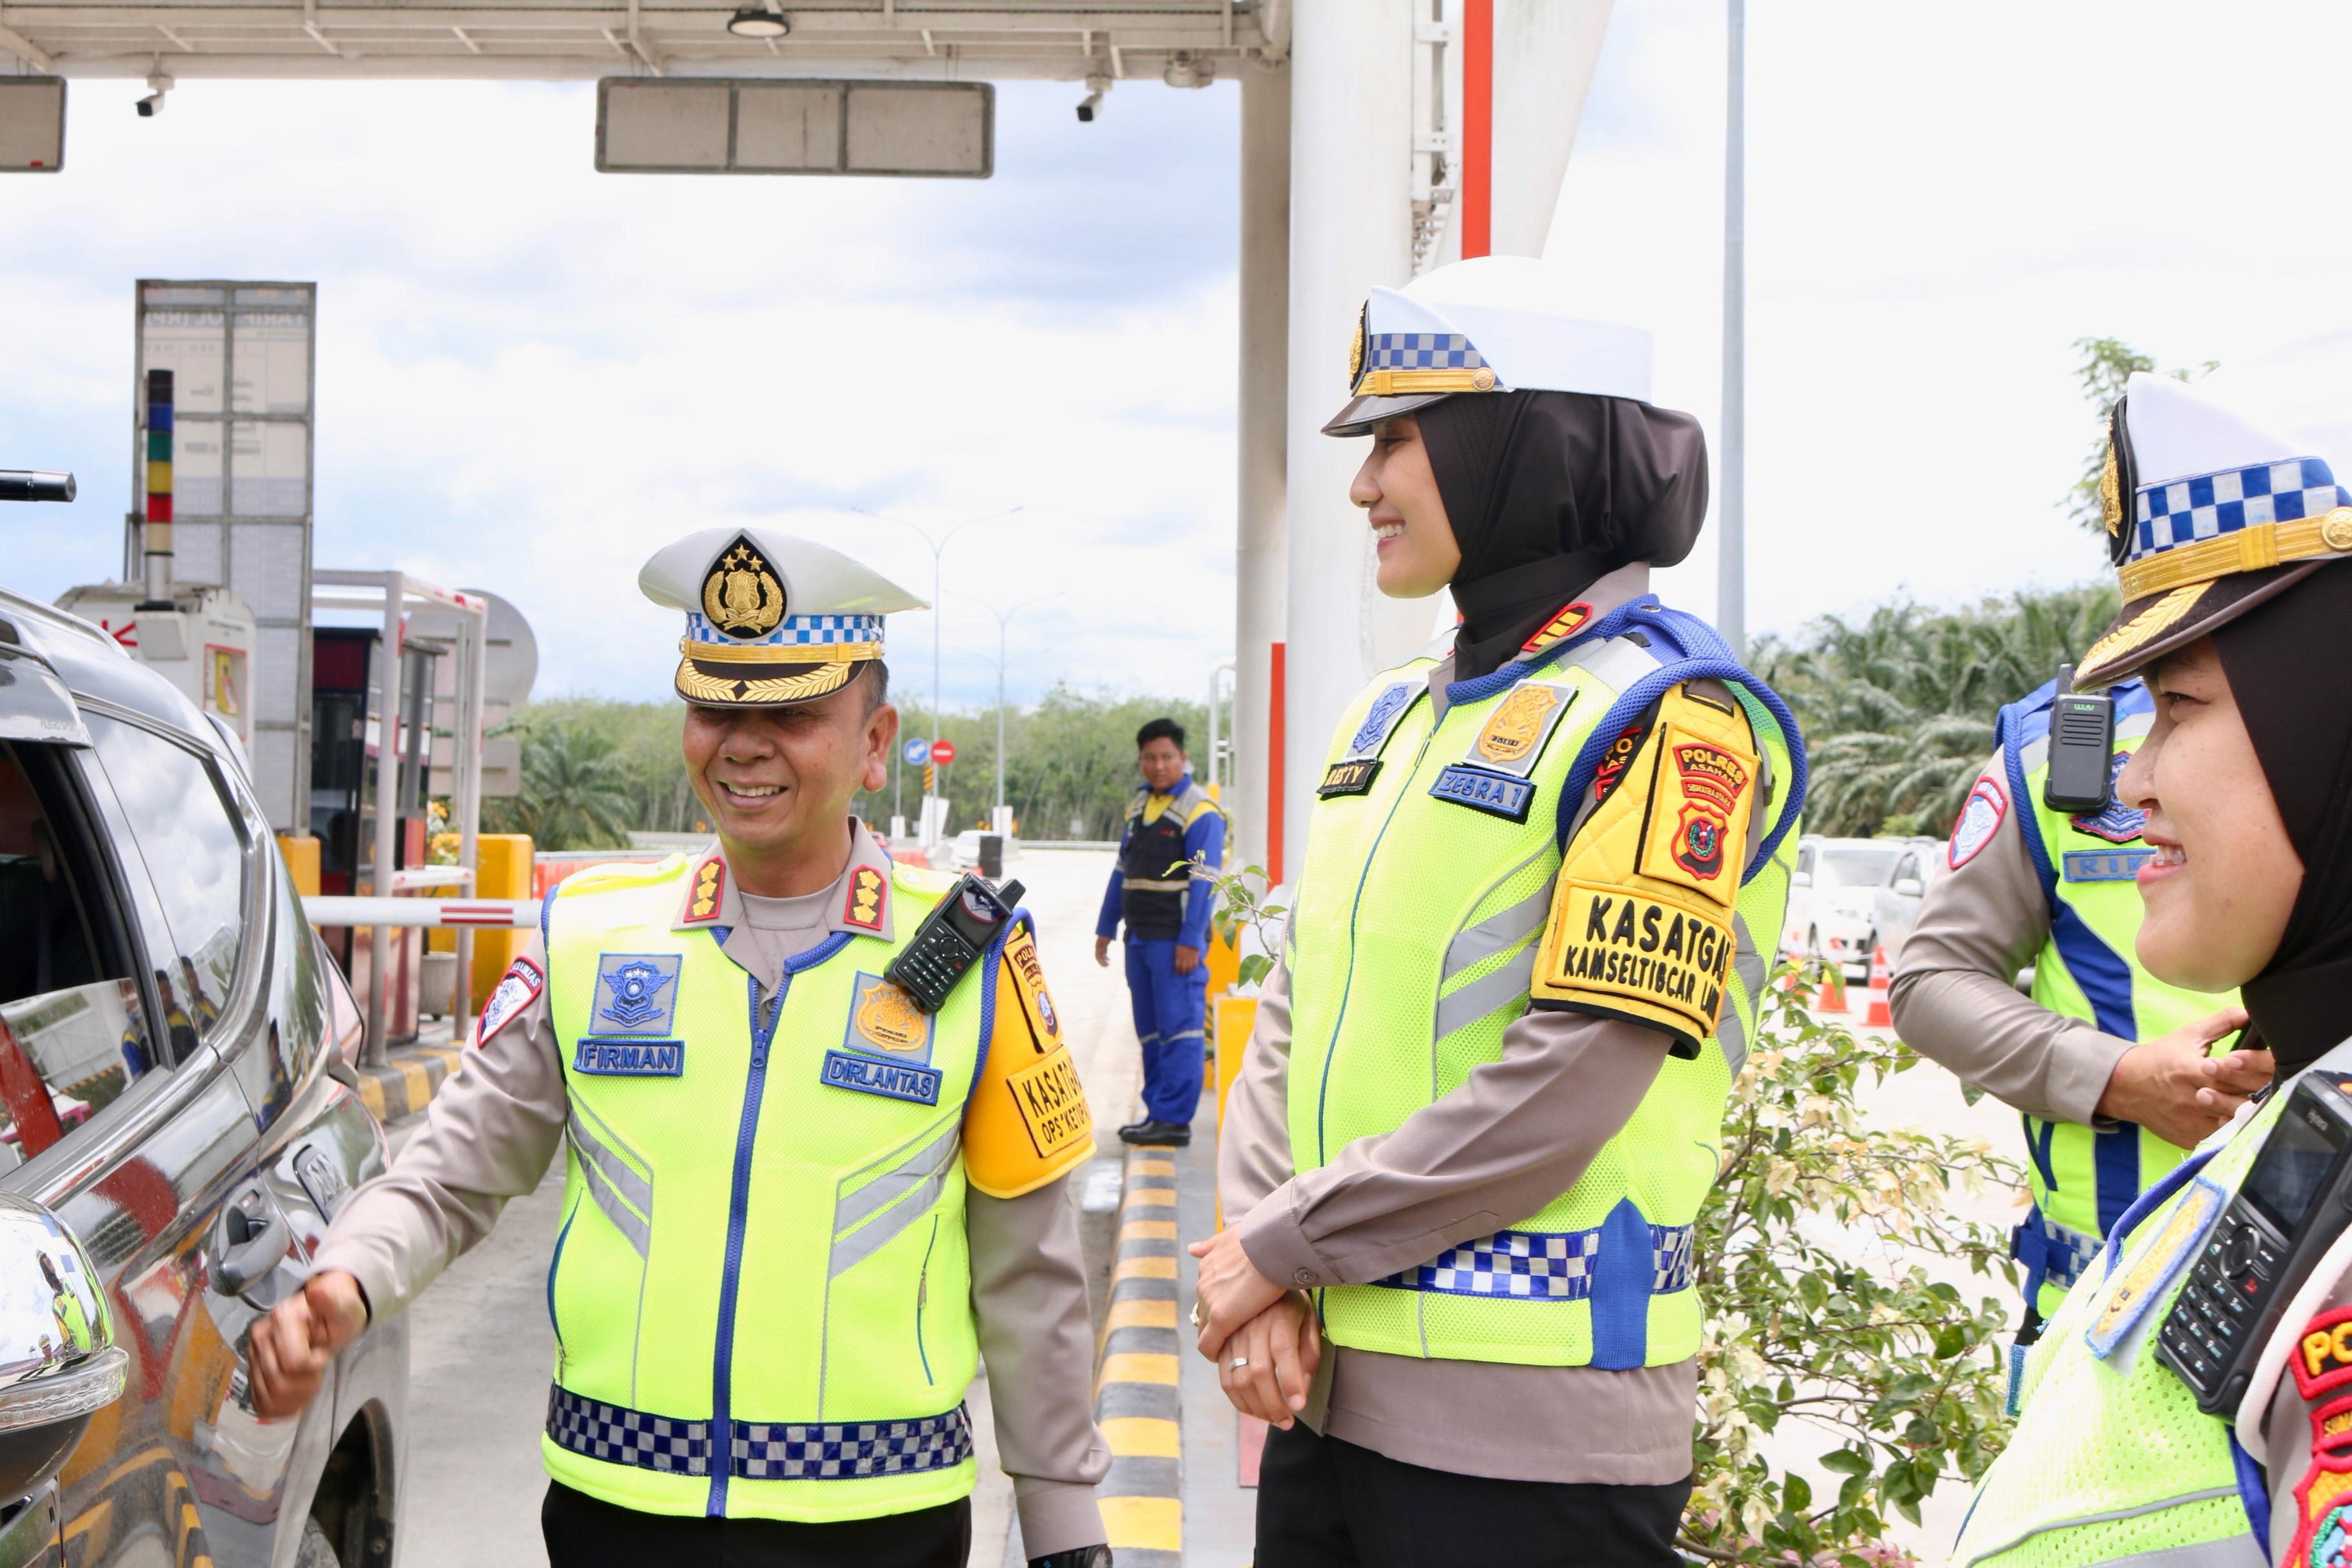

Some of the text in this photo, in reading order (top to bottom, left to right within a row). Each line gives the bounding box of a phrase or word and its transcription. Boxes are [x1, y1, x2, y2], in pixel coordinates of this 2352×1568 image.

[1681, 749, 1745, 785] POLRES
[1690, 763, 1736, 787] ASAHAN
[1438, 774, 1522, 807] ZEBRA 1
[2078, 855, 2144, 875] RIK
[1563, 945, 1696, 1004] KAMSELTIBCAR
[583, 1045, 675, 1069] FIRMAN
[830, 1058, 933, 1097] DIRLANTAS
[1022, 1055, 1082, 1118] KASATGA
[1041, 1116, 1064, 1144] OPS
